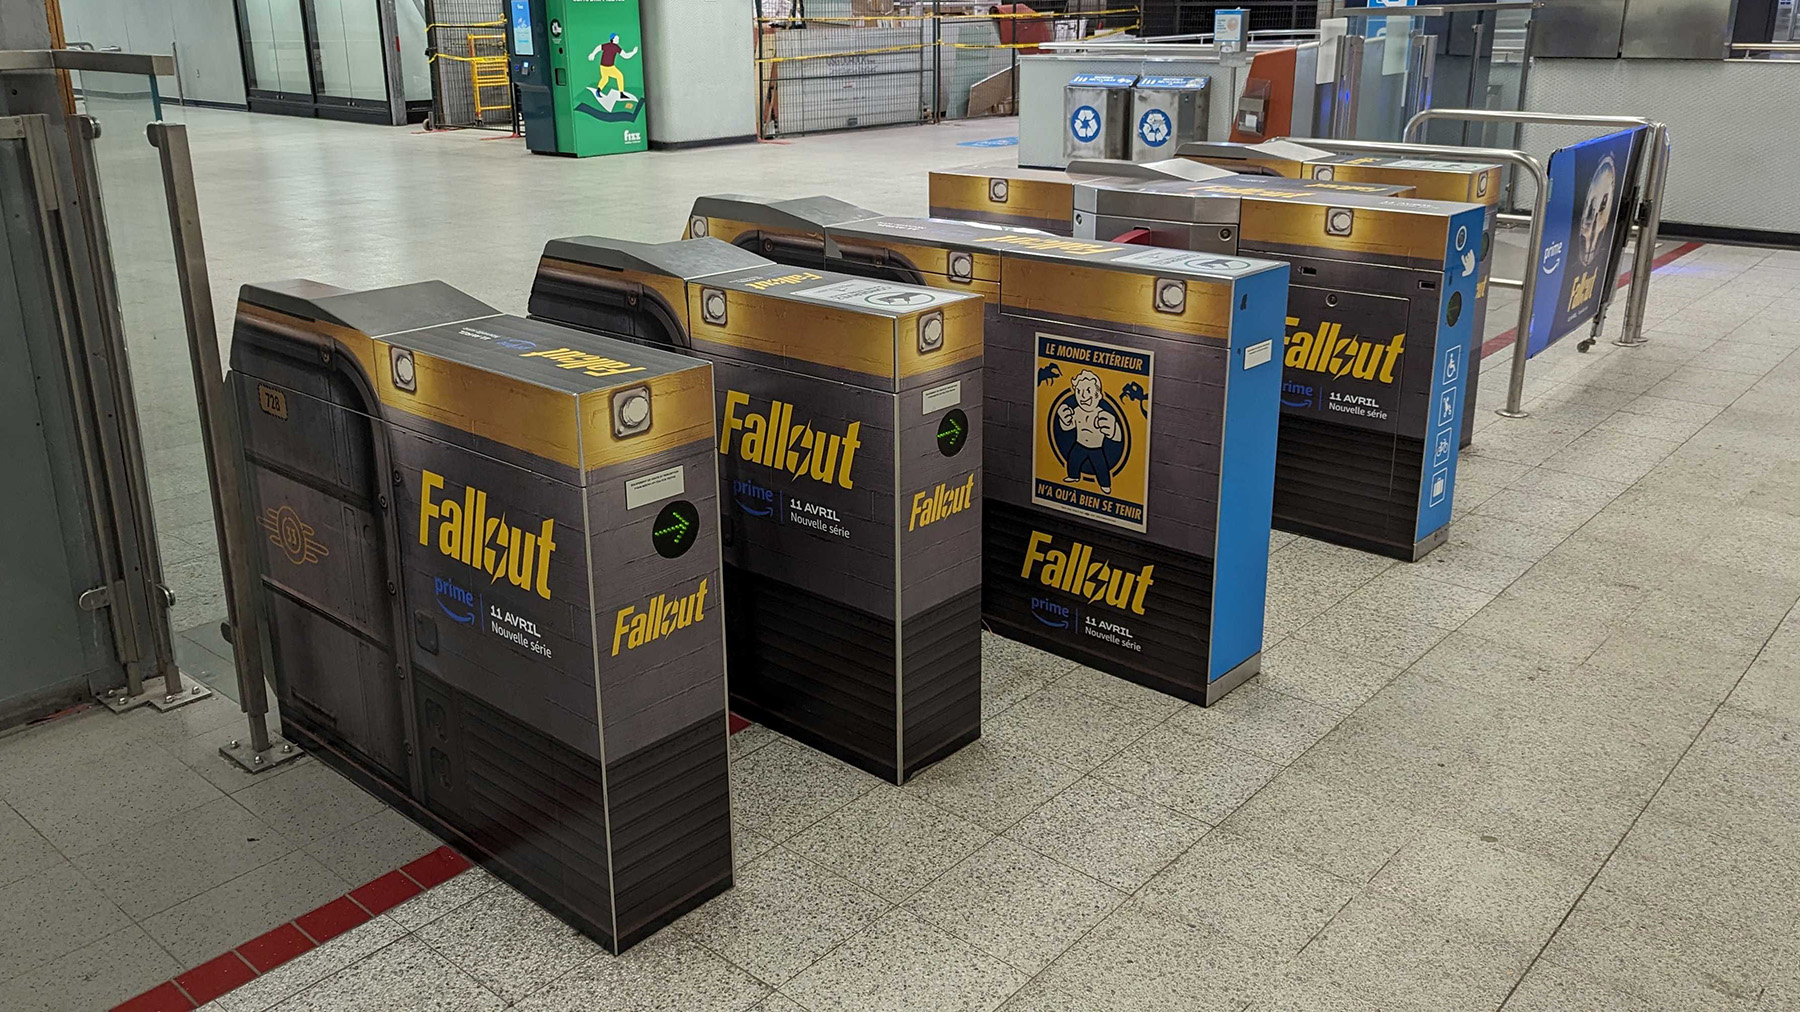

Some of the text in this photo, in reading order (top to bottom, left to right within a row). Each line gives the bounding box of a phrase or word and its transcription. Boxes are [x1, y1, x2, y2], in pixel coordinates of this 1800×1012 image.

[1543, 241, 1563, 264] prime
[744, 272, 823, 291] Fallout
[1567, 267, 1598, 313] Fallout
[520, 347, 646, 378] Fallout
[1045, 342, 1143, 371] LE MONDE EXTÉRIEUR
[264, 392, 281, 411] 728
[1281, 380, 1313, 397] rime
[1328, 392, 1380, 408] 11 AVRIL
[1328, 402, 1388, 420] Nouvelle série
[719, 390, 861, 490] Fallout
[733, 477, 774, 504] prime
[908, 473, 975, 532] Fallout
[1037, 483, 1053, 498] N'A
[1055, 487, 1077, 504] QU'À
[1079, 494, 1100, 510] BIEN
[1102, 500, 1113, 513] SE
[1115, 503, 1142, 520] TENIR
[790, 499, 841, 523] 11 AVRIL
[419, 470, 556, 600] Fallout
[790, 512, 851, 539] Nouvelle série
[1020, 531, 1155, 616] Fallout
[434, 577, 475, 609] prime
[490, 604, 541, 638] 11 AVRIL
[611, 578, 708, 657] Fallout
[1031, 597, 1070, 619] prime
[491, 620, 553, 659] Nouvelle série
[1085, 615, 1133, 639] 11 AVRIL
[1085, 625, 1142, 652] Nouvelle série
